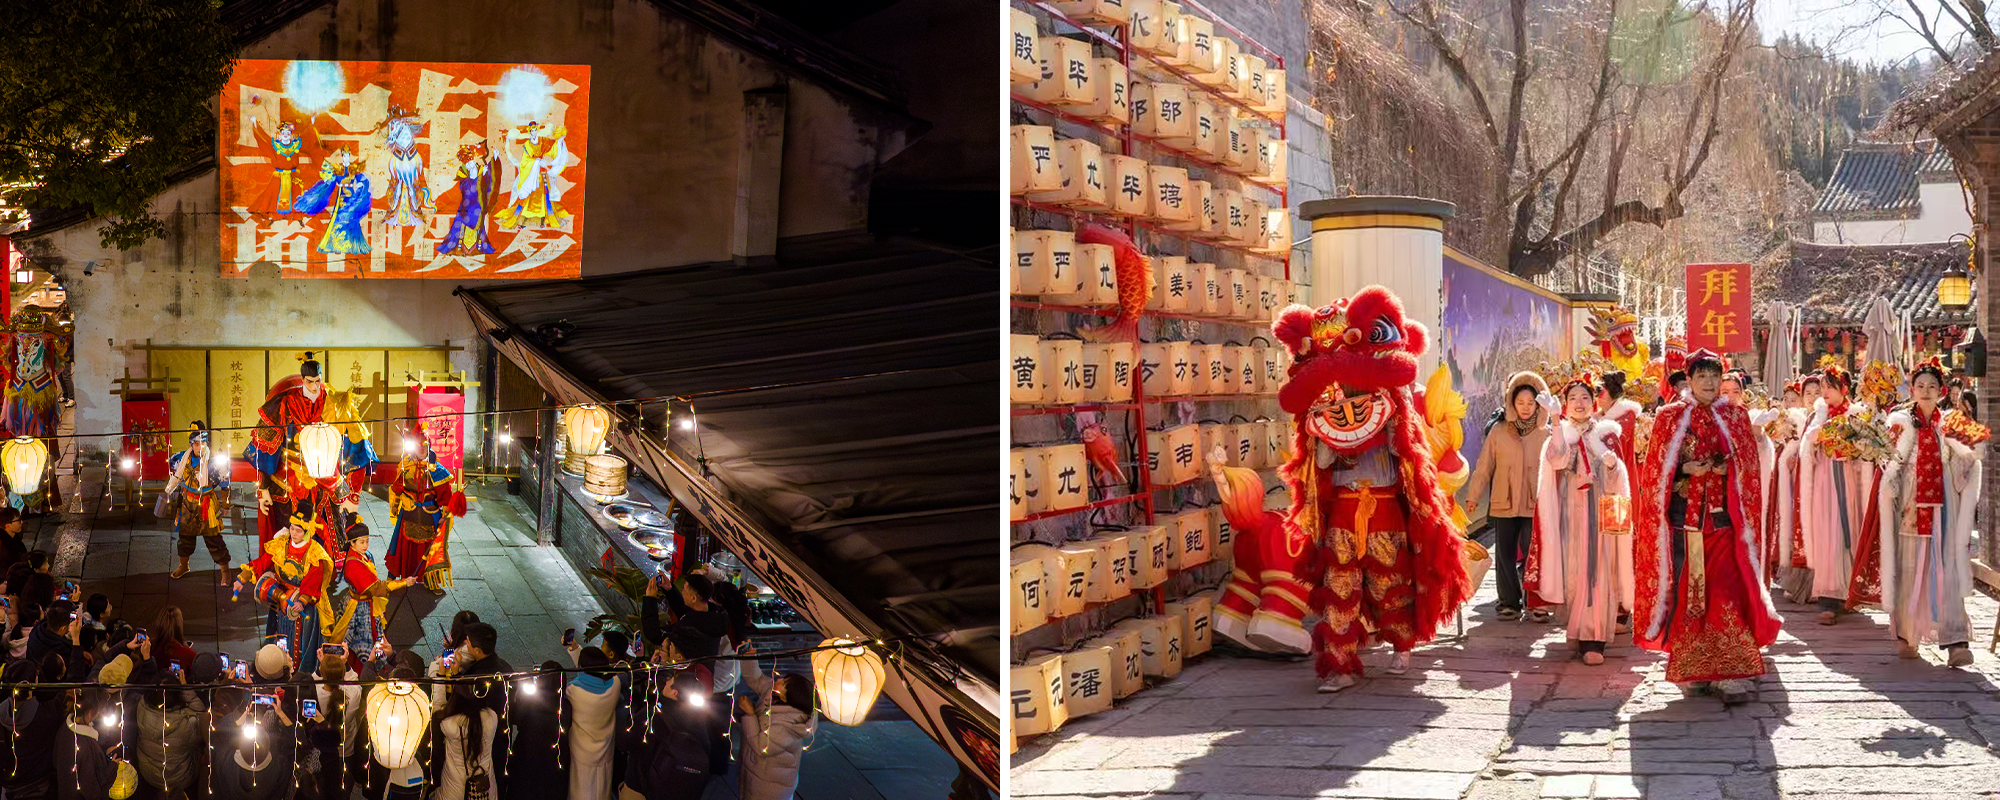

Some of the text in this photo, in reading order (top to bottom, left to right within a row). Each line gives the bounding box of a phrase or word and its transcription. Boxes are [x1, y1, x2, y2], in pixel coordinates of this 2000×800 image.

[1014, 31, 1037, 65] 殷
[1195, 33, 1210, 55] 平
[1068, 59, 1088, 89] 毕
[1161, 99, 1181, 123] 邬
[1031, 146, 1050, 173] 严
[1087, 161, 1100, 188] 尤
[1122, 175, 1141, 201] 毕
[1159, 183, 1182, 208] 蒋
[1054, 252, 1070, 278] 严
[1100, 263, 1113, 289] 尤
[1170, 273, 1184, 297] 姜
[1700, 268, 1738, 347] 拜年
[1013, 356, 1036, 389] 黄
[1065, 361, 1080, 389] 水
[1115, 361, 1129, 386] 陶
[1175, 359, 1188, 381] 方
[1243, 363, 1252, 384] 金
[230, 361, 243, 441] 枕水共度团圆年
[1175, 443, 1193, 467] 韦
[1058, 467, 1081, 494] 尤
[1185, 529, 1204, 553] 鲍
[1113, 557, 1126, 584] 贺
[1021, 578, 1040, 608] 何
[1067, 571, 1085, 598] 元
[1168, 637, 1179, 661] 齐
[1127, 653, 1139, 680] 沈
[1051, 677, 1064, 706] 元
[1070, 669, 1102, 698] 潘
